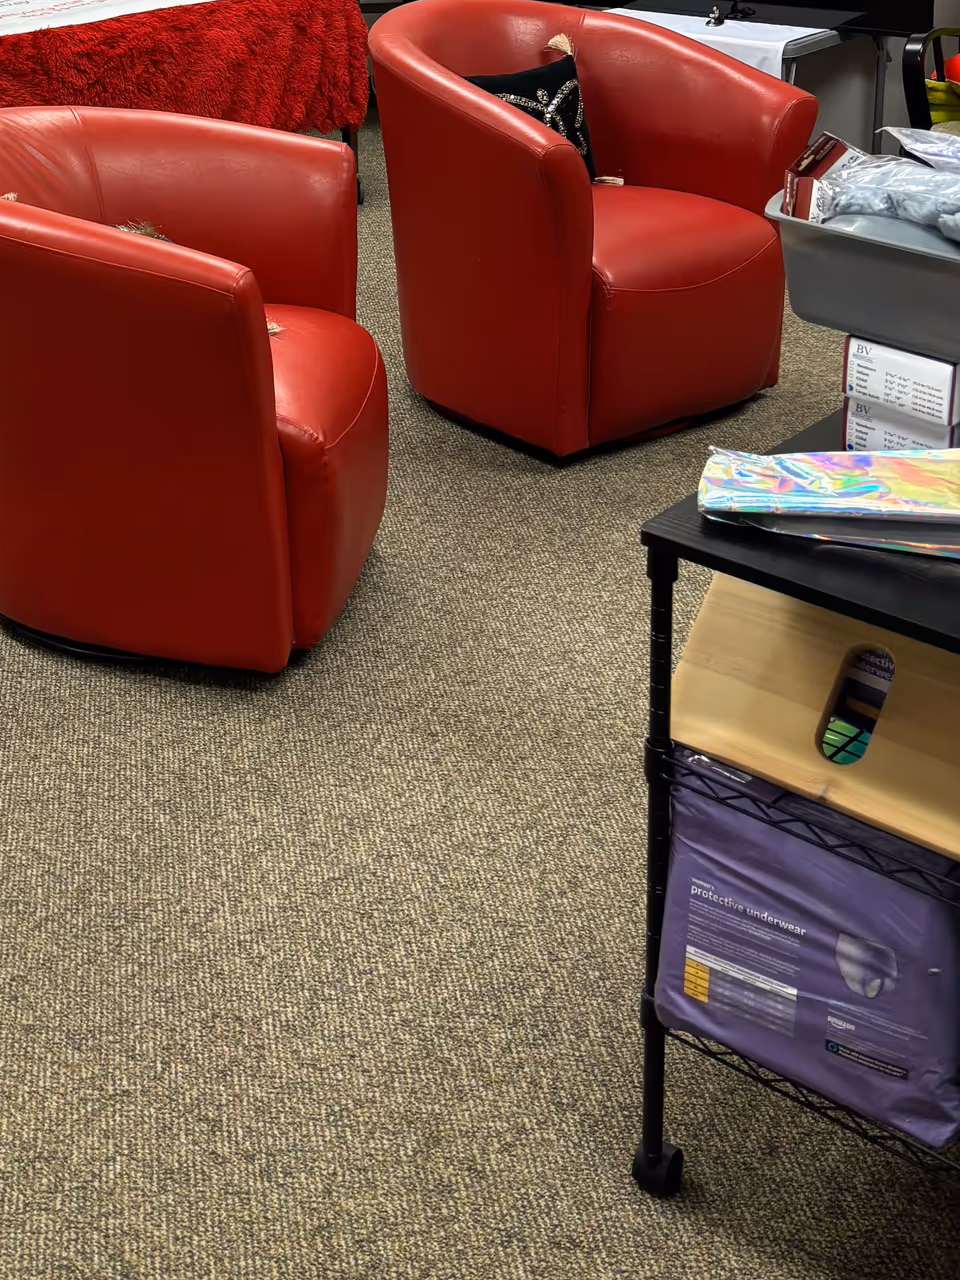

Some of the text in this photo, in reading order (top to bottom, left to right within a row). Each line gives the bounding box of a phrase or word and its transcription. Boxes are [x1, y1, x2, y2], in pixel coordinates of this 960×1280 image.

[856, 344, 872, 356] BV
[855, 403, 871, 415] BV
[690, 885, 807, 937] protective underwear
[827, 1015, 856, 1031] amazon
